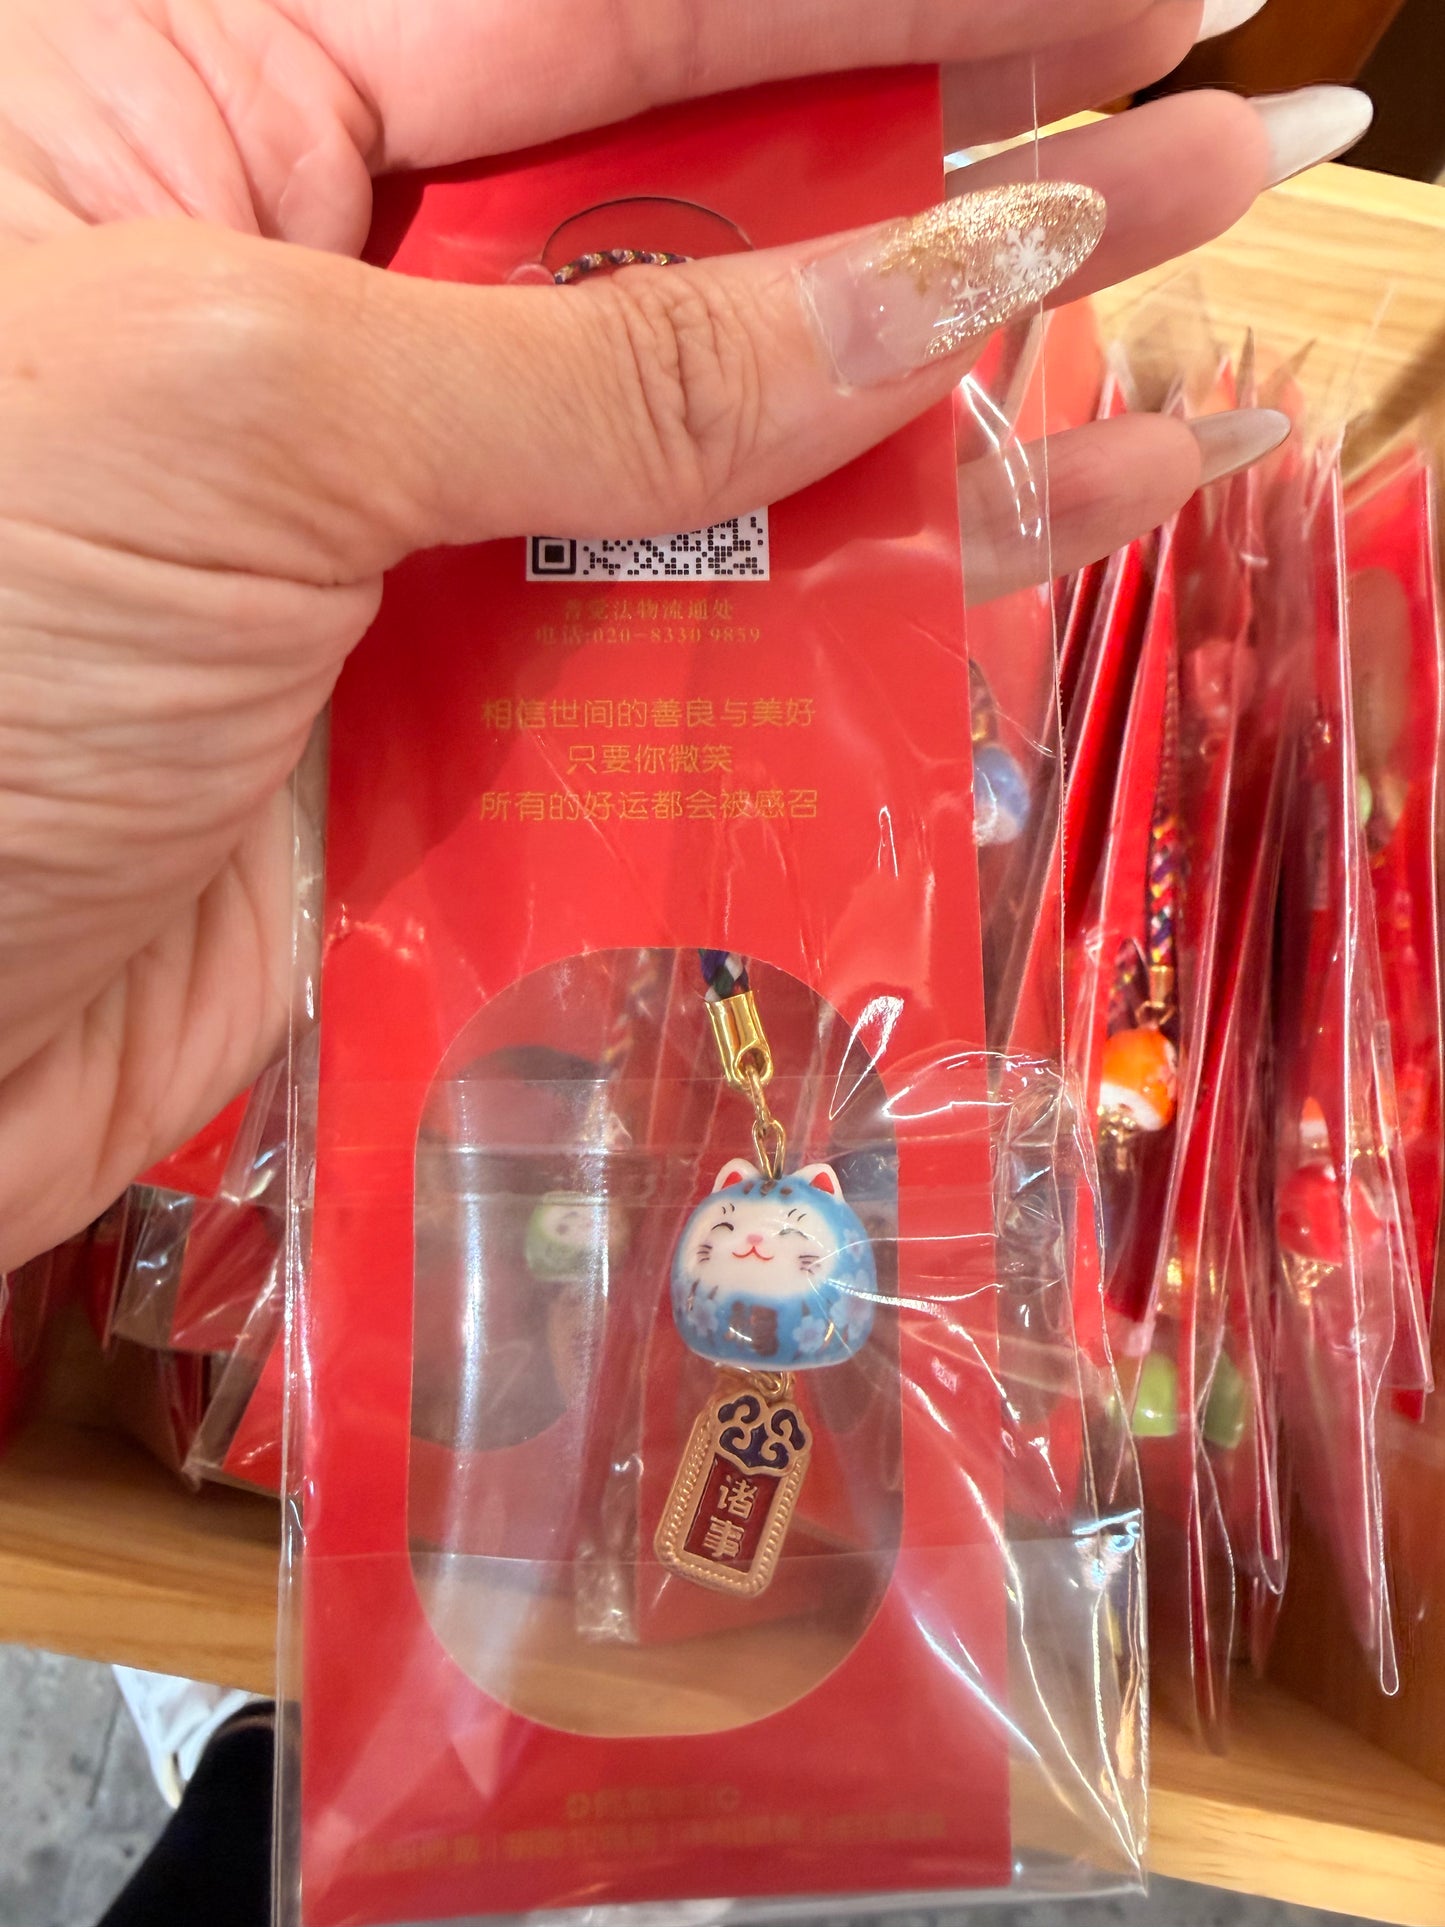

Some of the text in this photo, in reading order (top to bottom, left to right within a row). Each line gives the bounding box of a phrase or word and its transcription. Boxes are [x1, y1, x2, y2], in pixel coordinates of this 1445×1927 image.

[709, 627, 761, 643] 9859
[481, 698, 816, 728] 相信世间的善良与美好
[566, 744, 733, 774] 只要你微笑
[480, 790, 818, 821] 所有的好运都会被感召
[703, 1475, 758, 1557] 诸事
